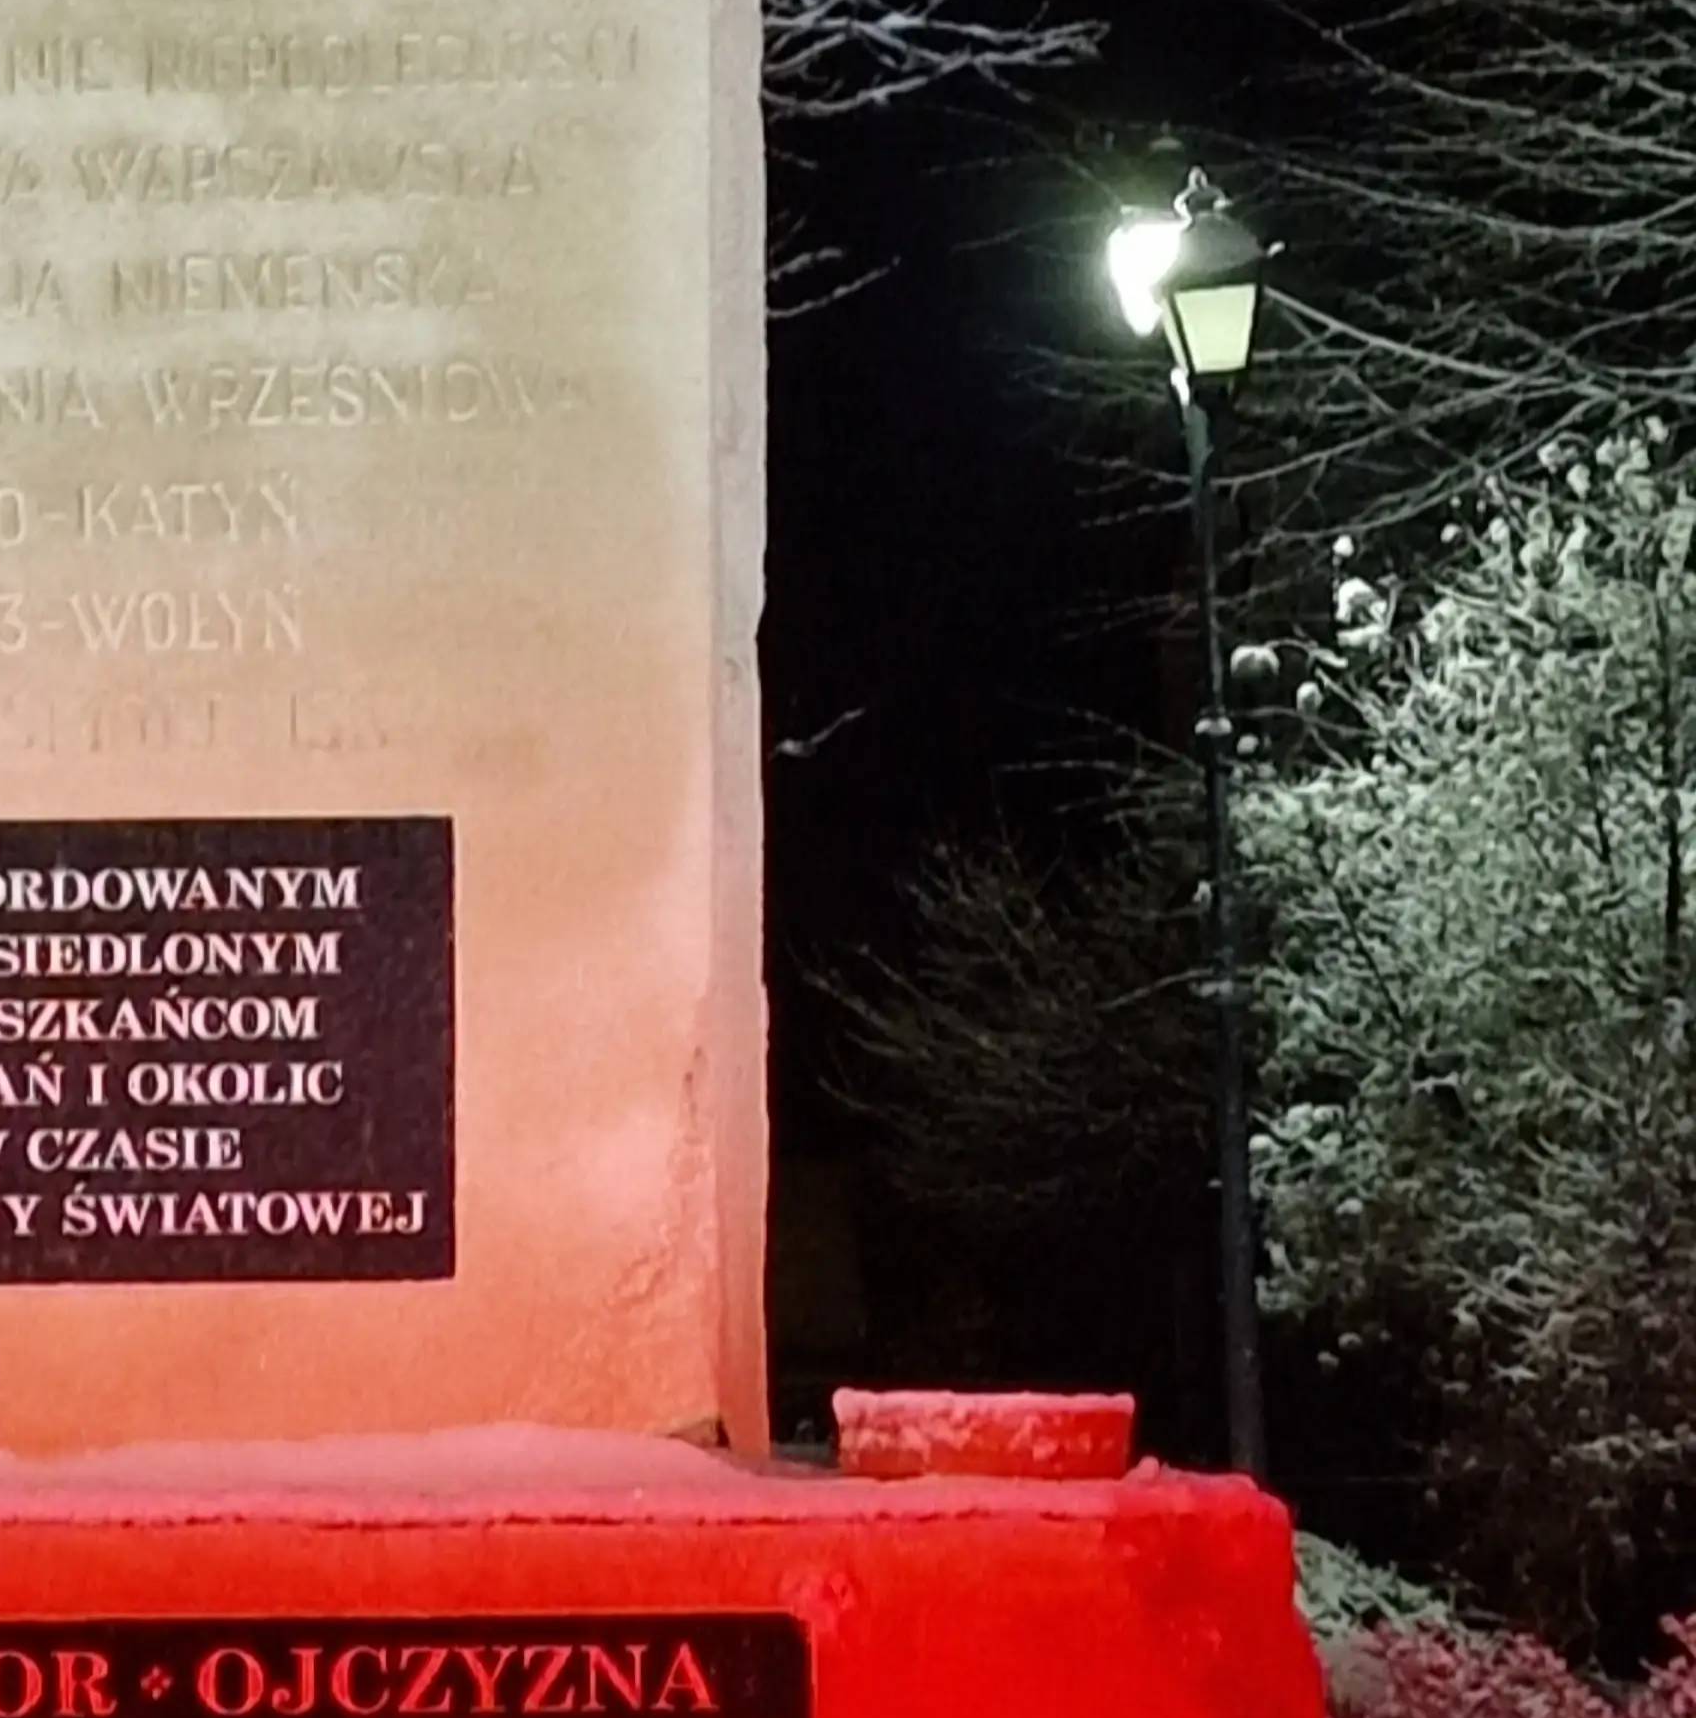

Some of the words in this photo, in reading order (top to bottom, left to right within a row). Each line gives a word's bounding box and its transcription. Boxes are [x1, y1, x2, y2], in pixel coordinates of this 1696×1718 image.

[86, 1066, 104, 1106] I
[129, 1062, 344, 1106] OKOLIC
[27, 1128, 242, 1171] CZASIE
[63, 1184, 428, 1237] ŚWIATOWEJ
[197, 1642, 720, 1717] OJCZYZNA
